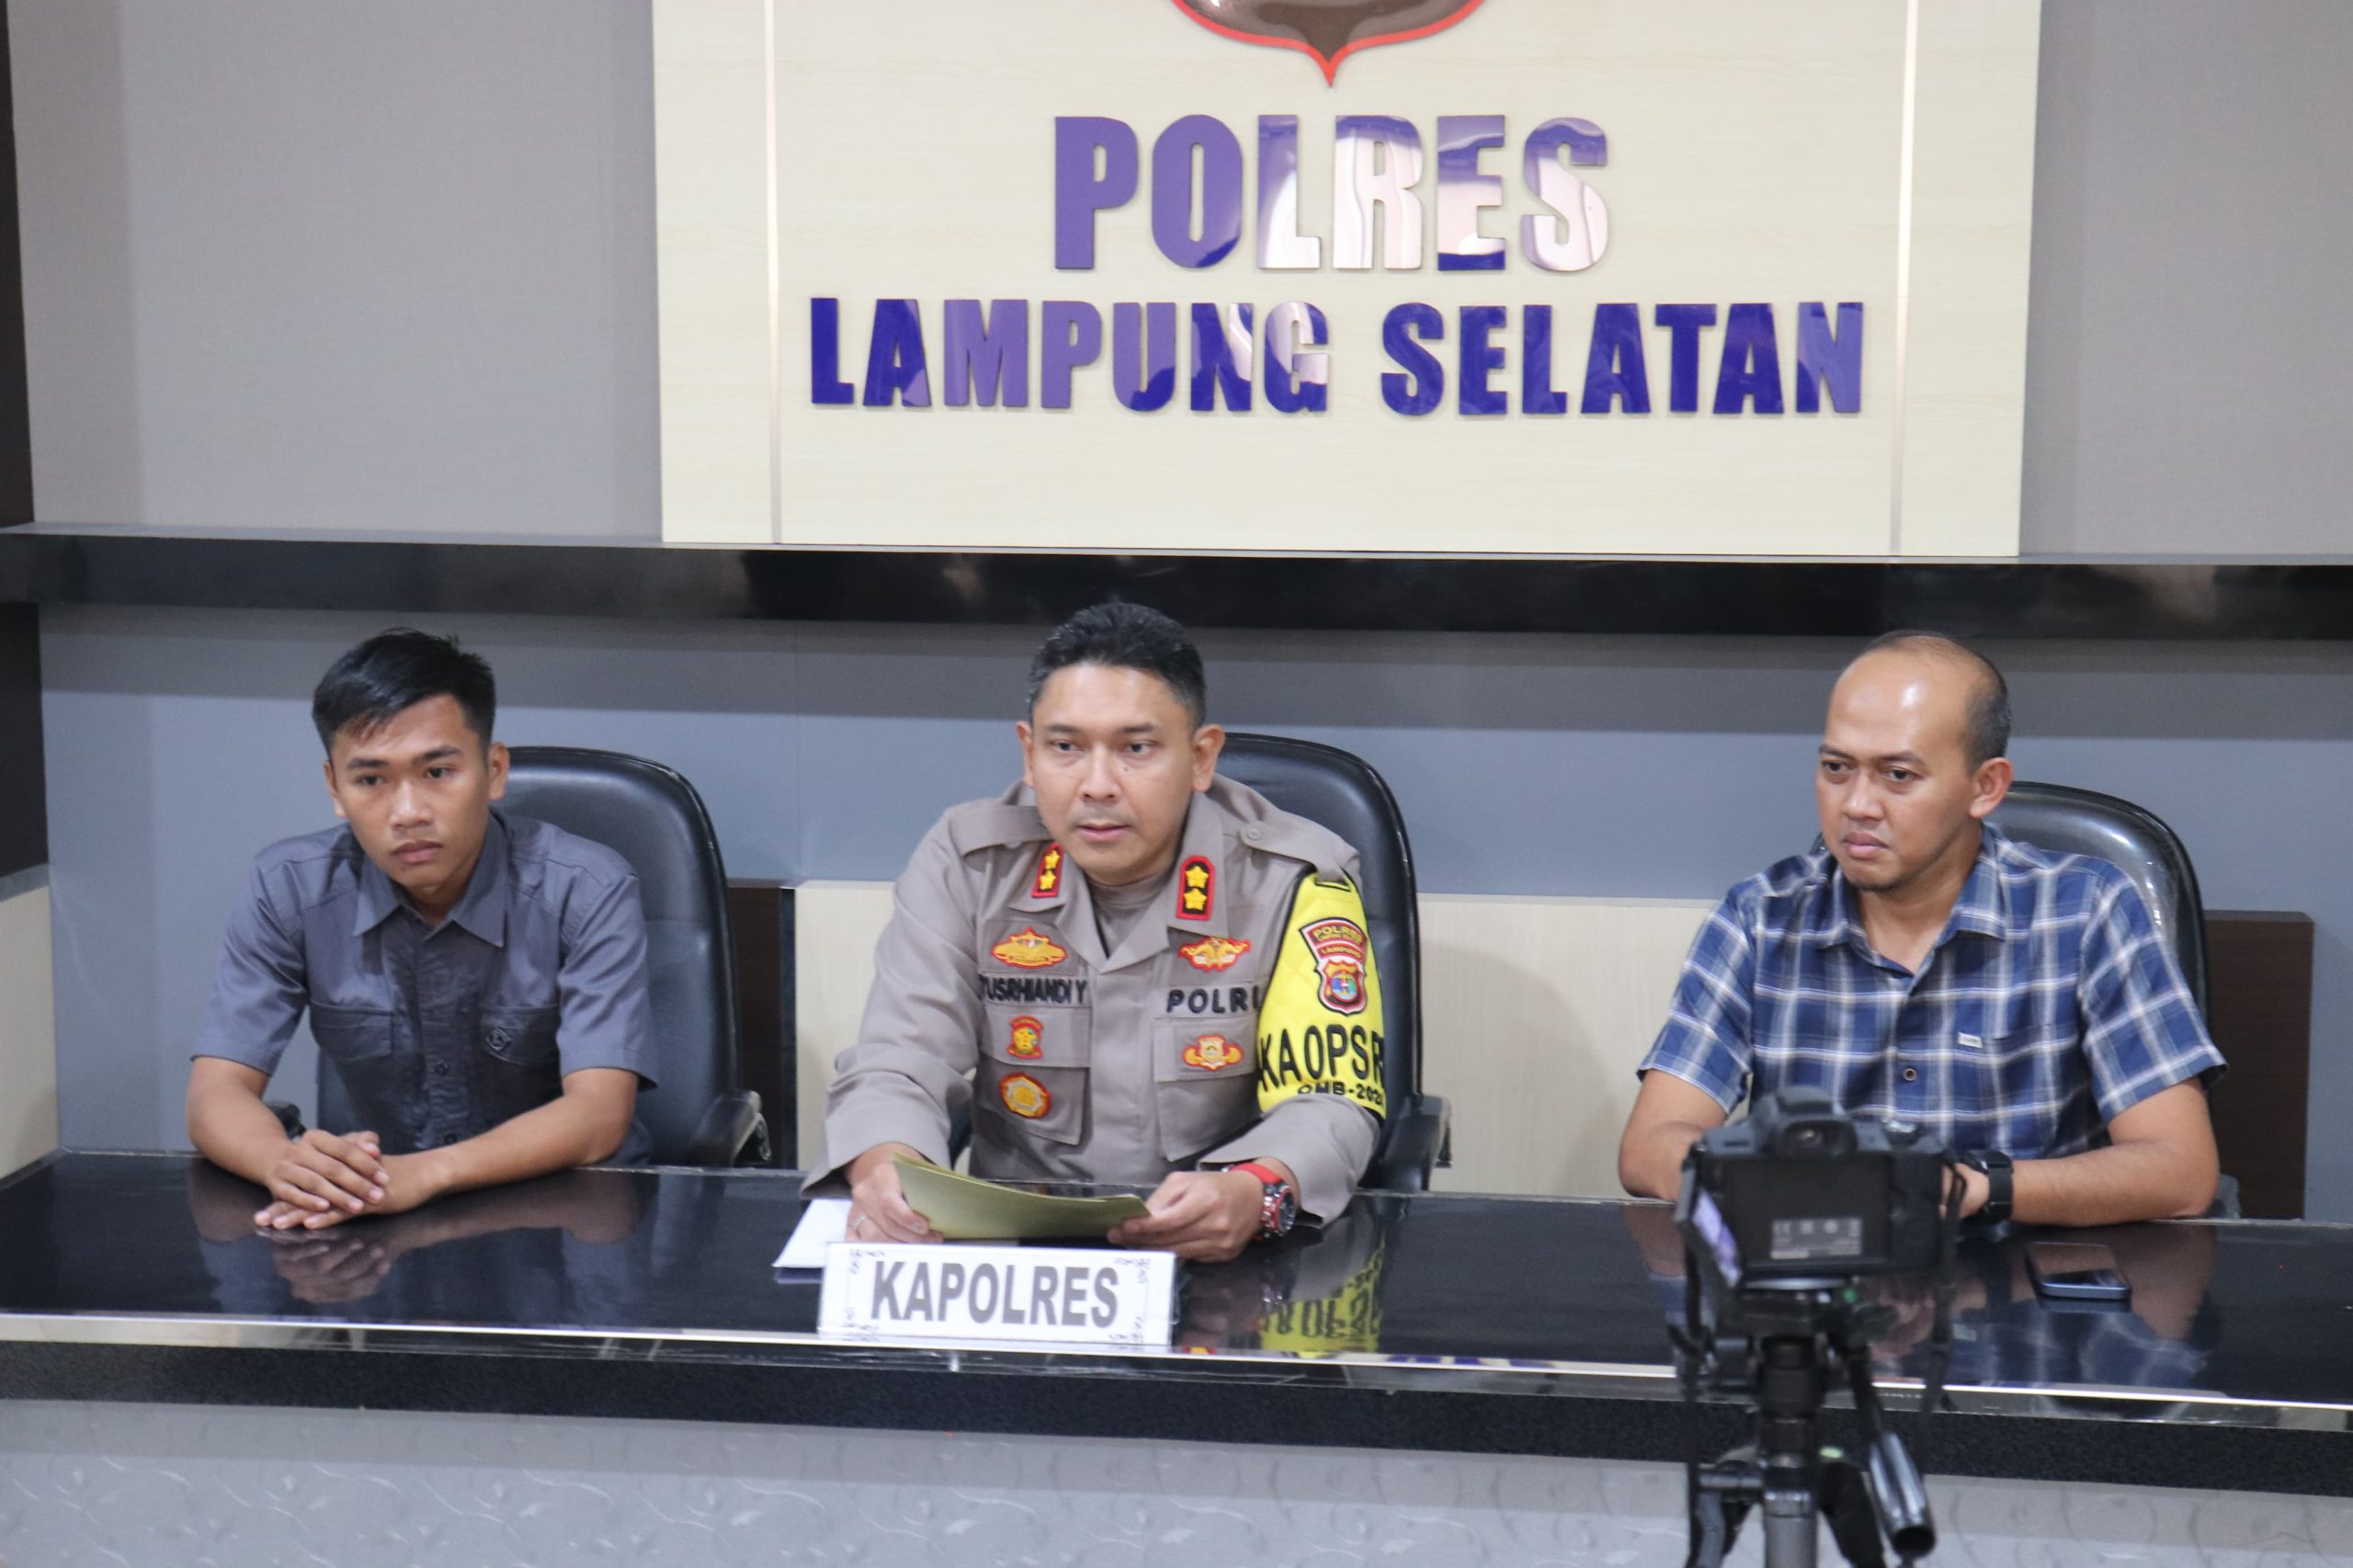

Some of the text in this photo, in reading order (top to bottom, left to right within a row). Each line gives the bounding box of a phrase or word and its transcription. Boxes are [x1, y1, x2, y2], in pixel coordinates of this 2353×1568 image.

[1054, 114, 1608, 273] POLRES
[810, 297, 1863, 417] LAMPUNG SELATAN
[1166, 985, 1259, 1014] POLRI
[870, 1261, 1118, 1329] KAPOLRES
